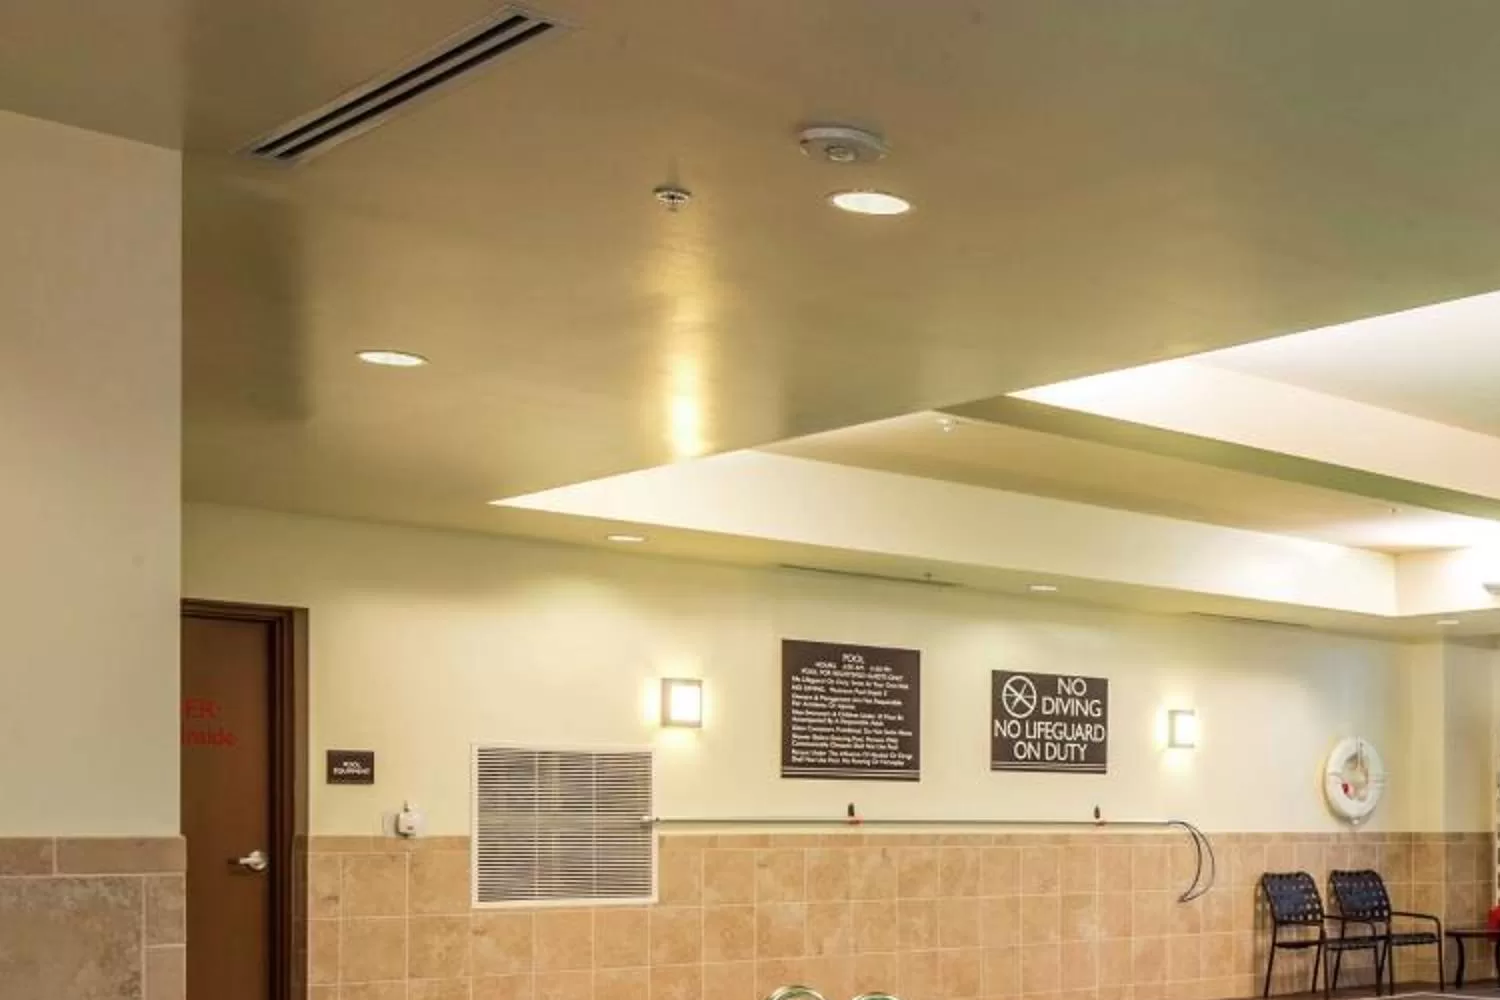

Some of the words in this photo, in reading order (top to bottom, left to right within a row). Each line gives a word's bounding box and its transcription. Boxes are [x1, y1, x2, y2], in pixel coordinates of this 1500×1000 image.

[1057, 677, 1087, 697] NO
[1041, 696, 1102, 718] DIVING
[994, 719, 1021, 739] NO
[1025, 721, 1105, 742] LIFEGUARD
[1013, 741, 1041, 760] ON
[1045, 742, 1088, 761] DUTY
